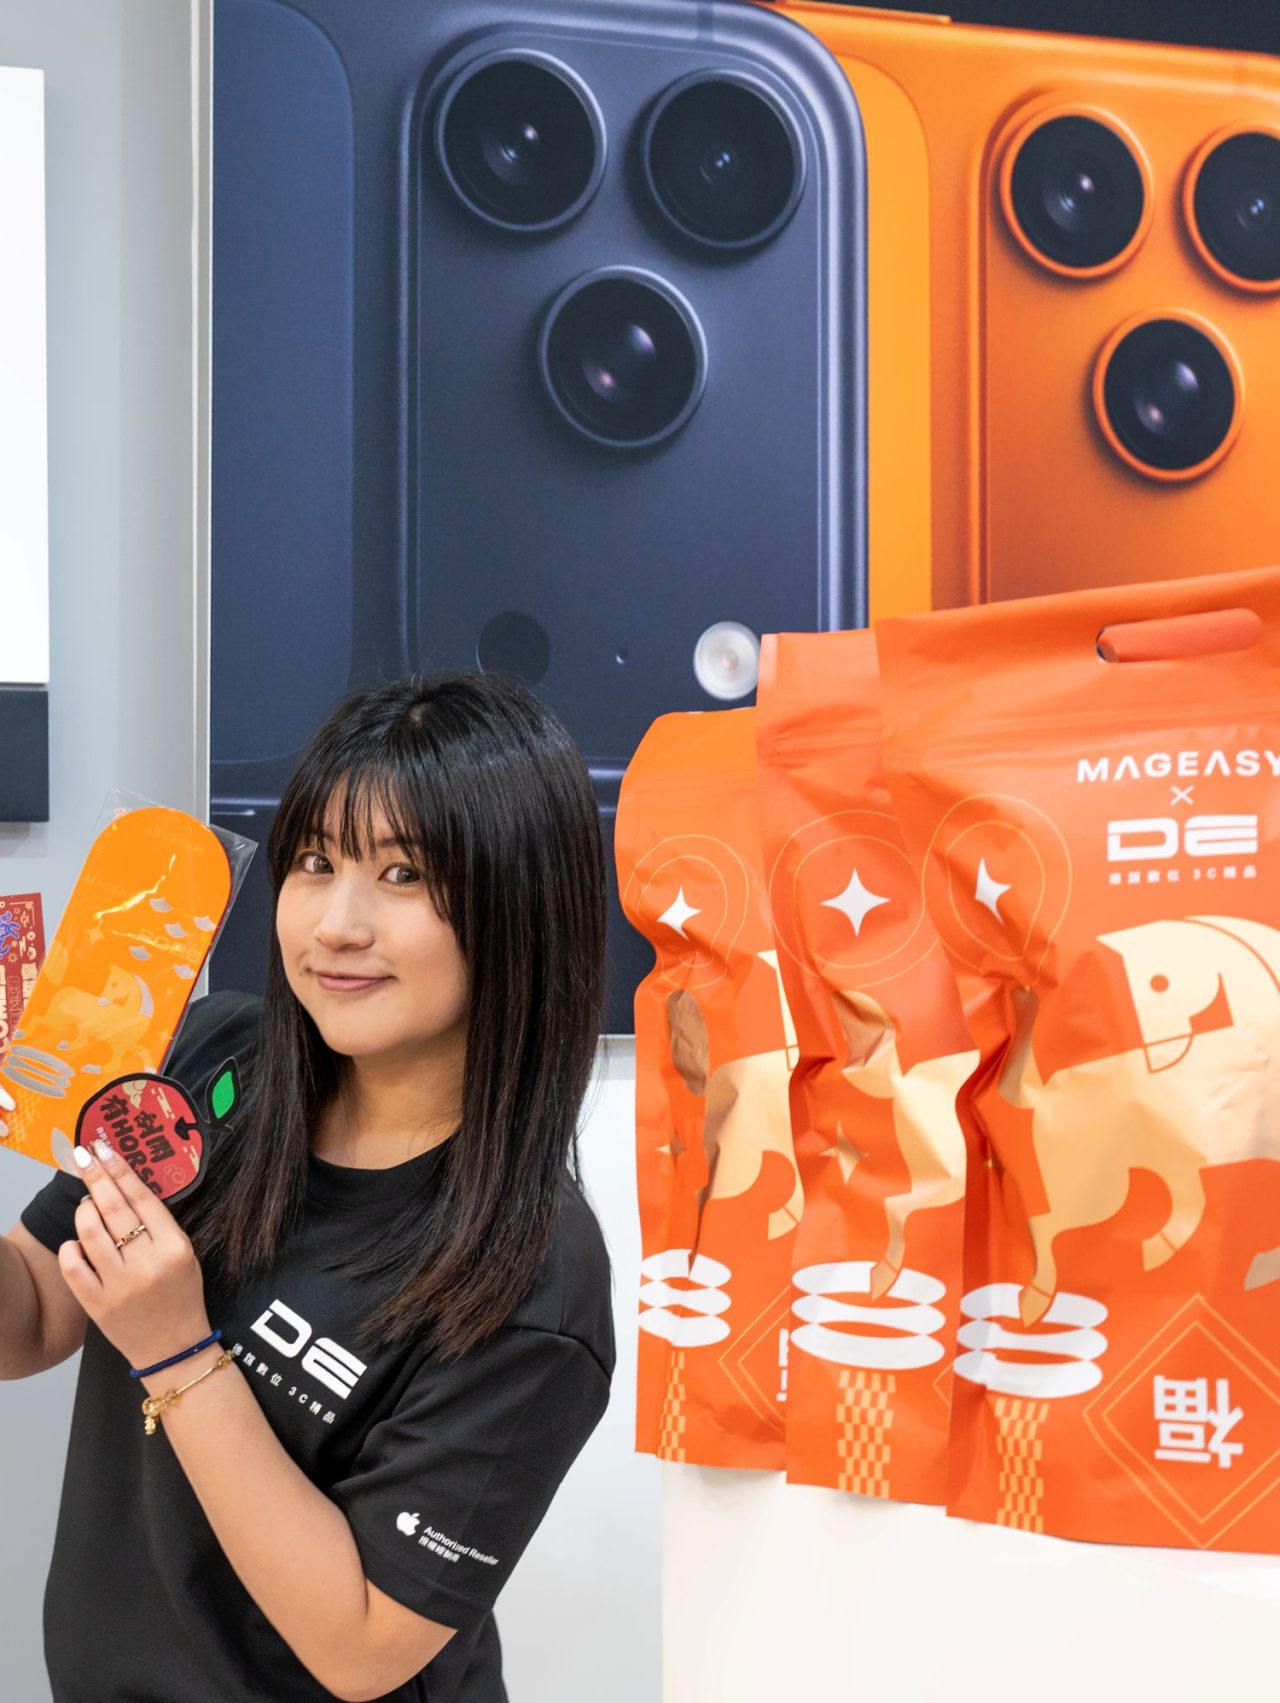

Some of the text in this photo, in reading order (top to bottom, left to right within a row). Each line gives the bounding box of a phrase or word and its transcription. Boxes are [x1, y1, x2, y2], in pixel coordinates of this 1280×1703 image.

[1076, 749, 1280, 783] MAGEASY
[1106, 814, 1258, 862] DE
[250, 1298, 368, 1400] DE
[1152, 1374, 1245, 1468] 福
[422, 1525, 471, 1555] Authorized
